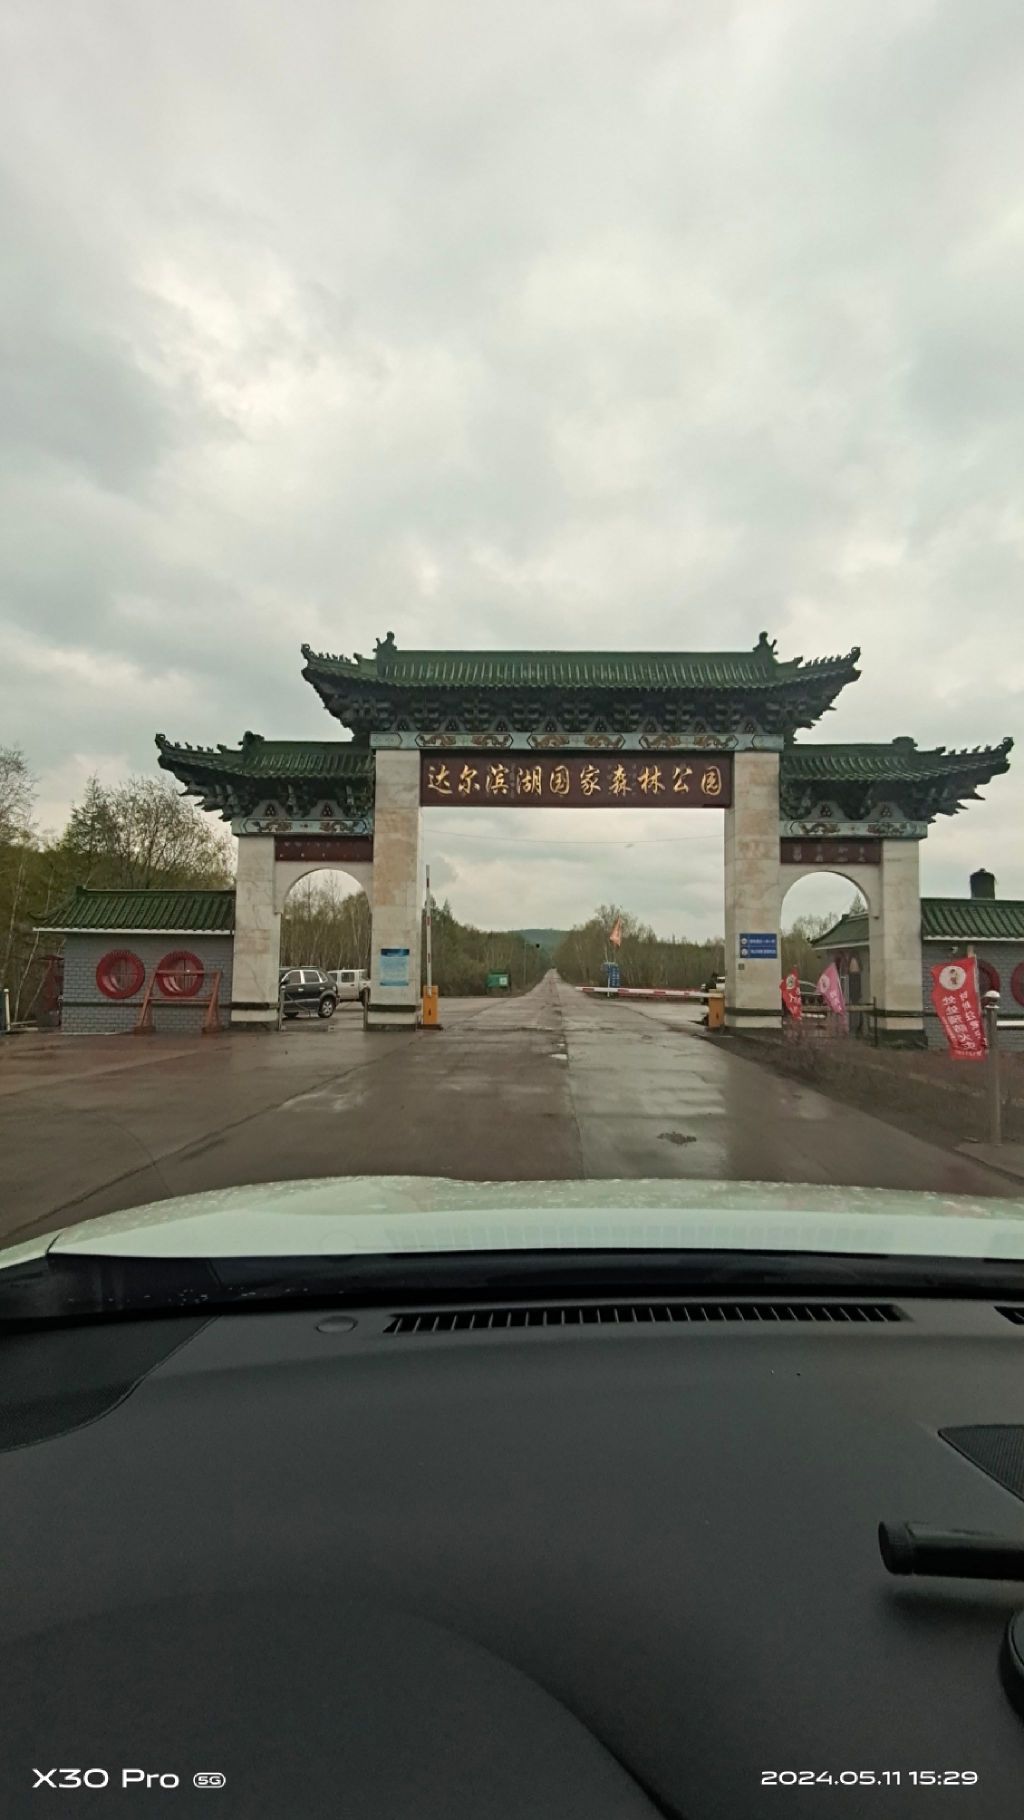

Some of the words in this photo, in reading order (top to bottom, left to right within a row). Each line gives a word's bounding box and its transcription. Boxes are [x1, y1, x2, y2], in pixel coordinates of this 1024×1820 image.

[427, 763, 723, 797] 达尔滨湖国家森林公园
